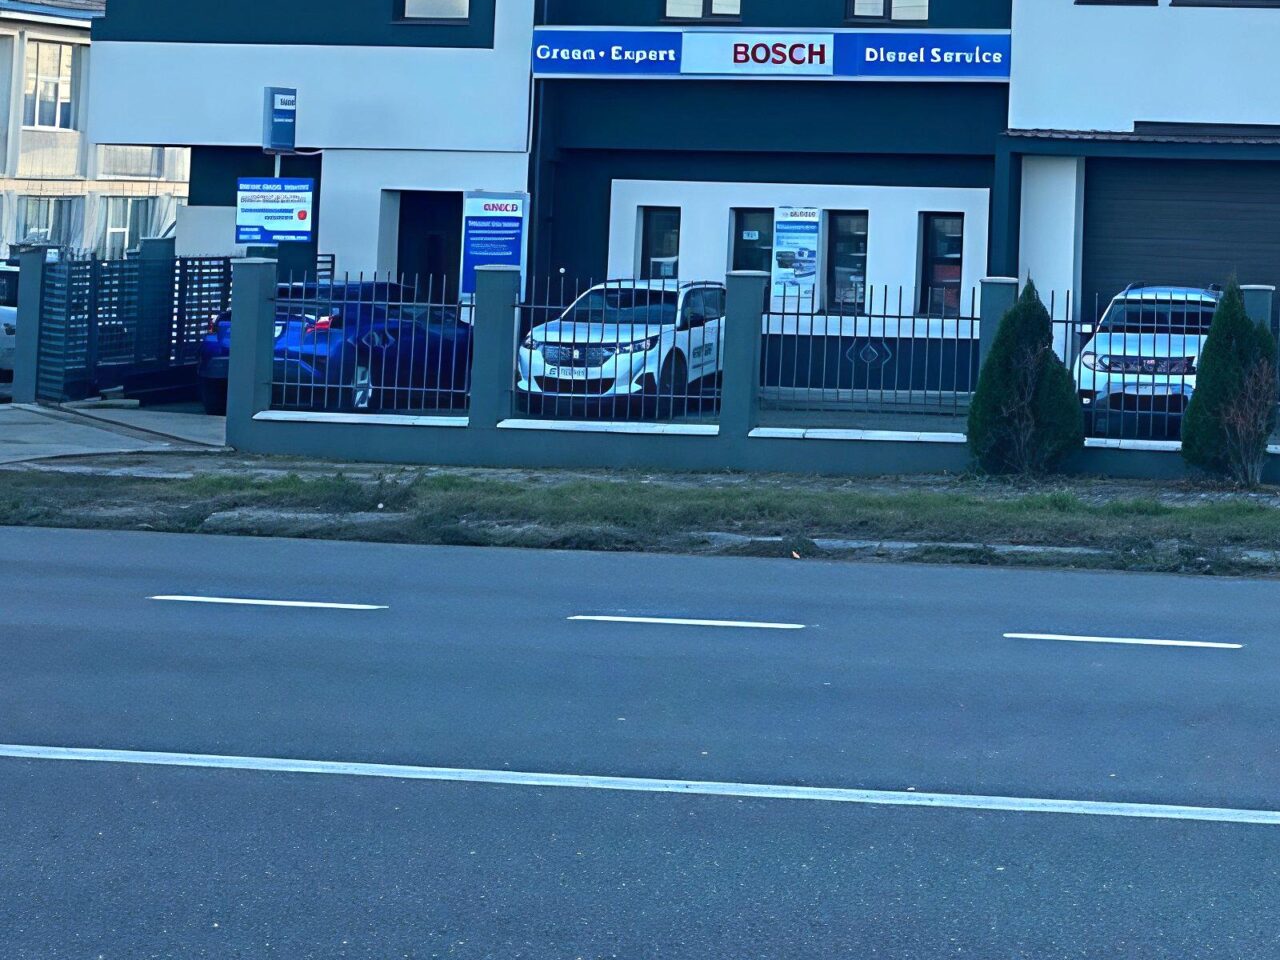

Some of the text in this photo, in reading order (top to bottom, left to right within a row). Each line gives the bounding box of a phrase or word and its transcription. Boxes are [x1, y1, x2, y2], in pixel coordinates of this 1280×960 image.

[610, 46, 676, 64] Expert
[733, 43, 826, 65] BOSCH
[865, 45, 1003, 63] Diesel Service
